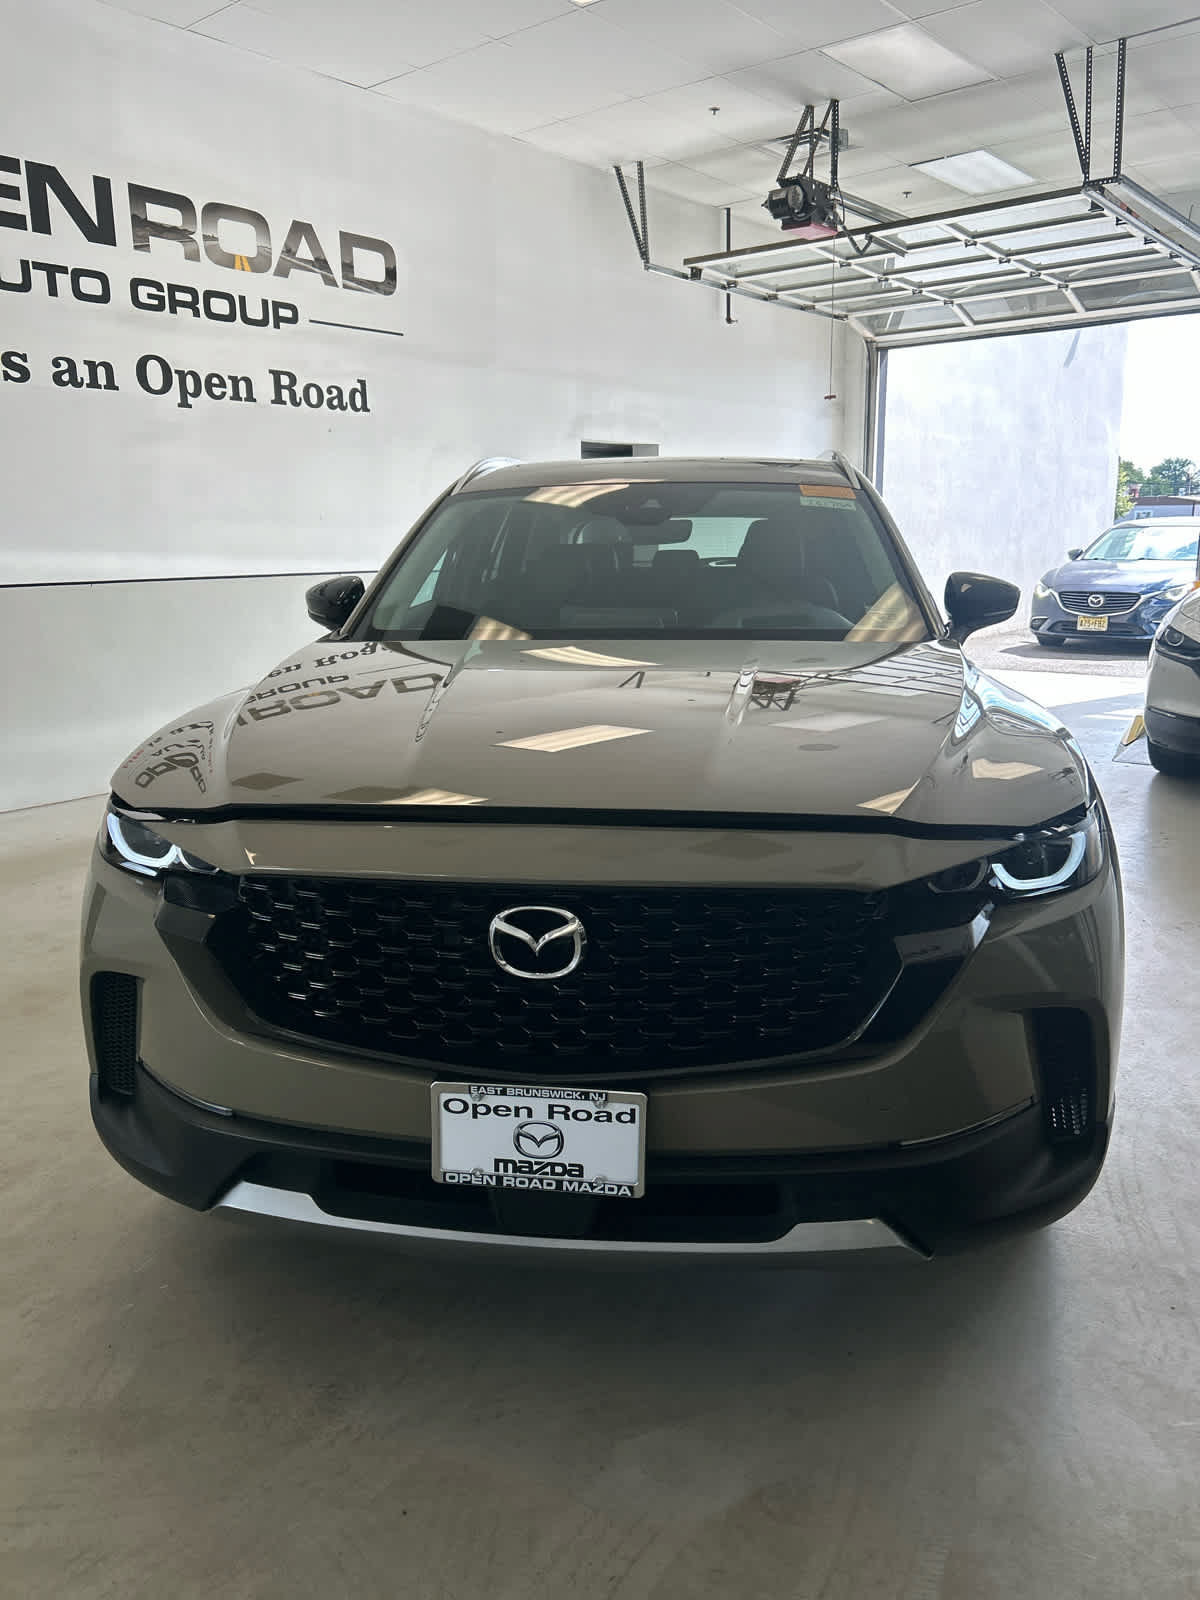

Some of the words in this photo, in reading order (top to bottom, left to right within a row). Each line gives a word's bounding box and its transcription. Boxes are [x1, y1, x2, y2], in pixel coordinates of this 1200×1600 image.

[127, 182, 398, 296] ROAD
[129, 277, 299, 329] GROUP
[51, 353, 119, 391] an
[135, 353, 257, 408] Open
[268, 368, 371, 413] Road
[443, 1097, 533, 1119] Open
[547, 1103, 636, 1124] Road
[470, 1085, 503, 1095] EAST
[589, 1091, 606, 1101] NJ
[445, 1172, 497, 1185] OPEN
[503, 1176, 556, 1190] ROAD
[562, 1180, 632, 1196] MAZDA
